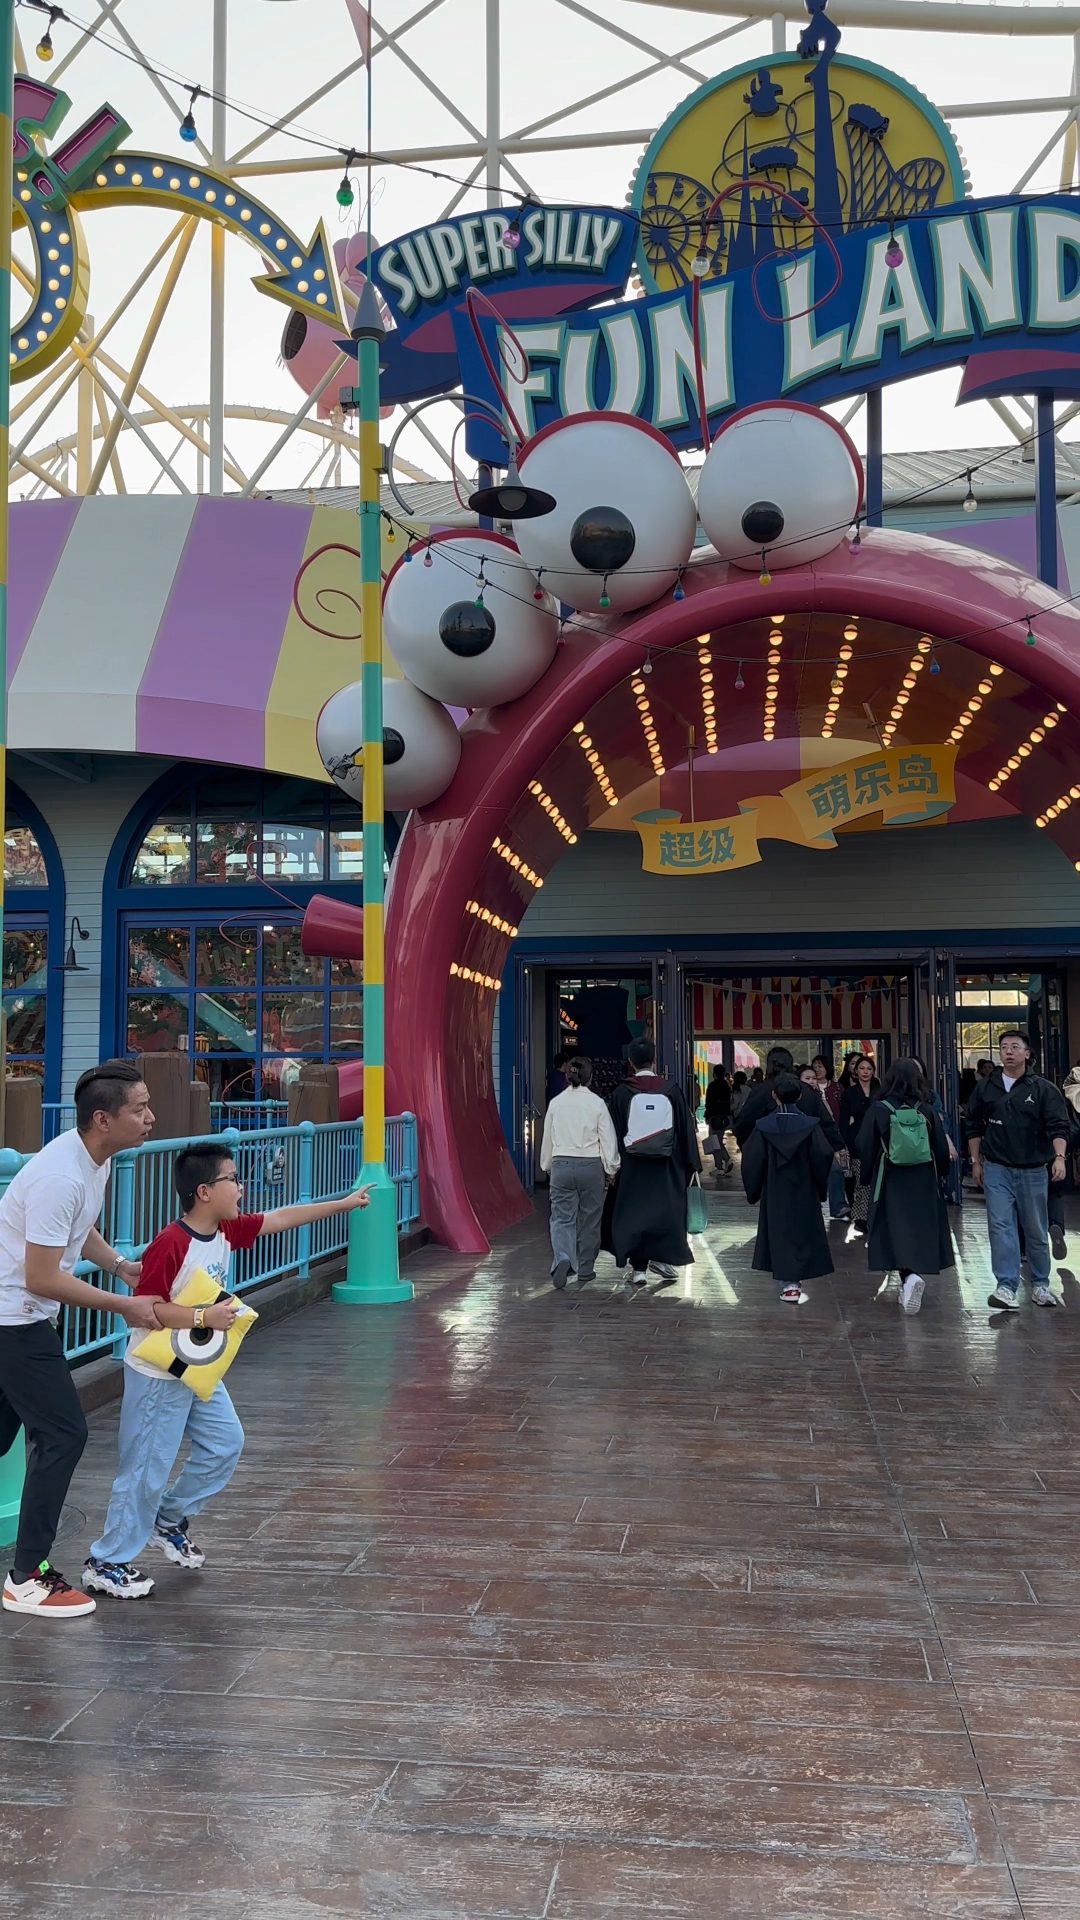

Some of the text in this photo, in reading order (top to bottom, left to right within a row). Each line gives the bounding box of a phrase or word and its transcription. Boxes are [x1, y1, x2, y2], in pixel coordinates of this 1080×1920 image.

[378, 210, 622, 317] SUPER SILLY
[496, 205, 1080, 443] FUN LAND
[806, 754, 938, 819] 萌乐岛
[659, 826, 736, 867] 超级
